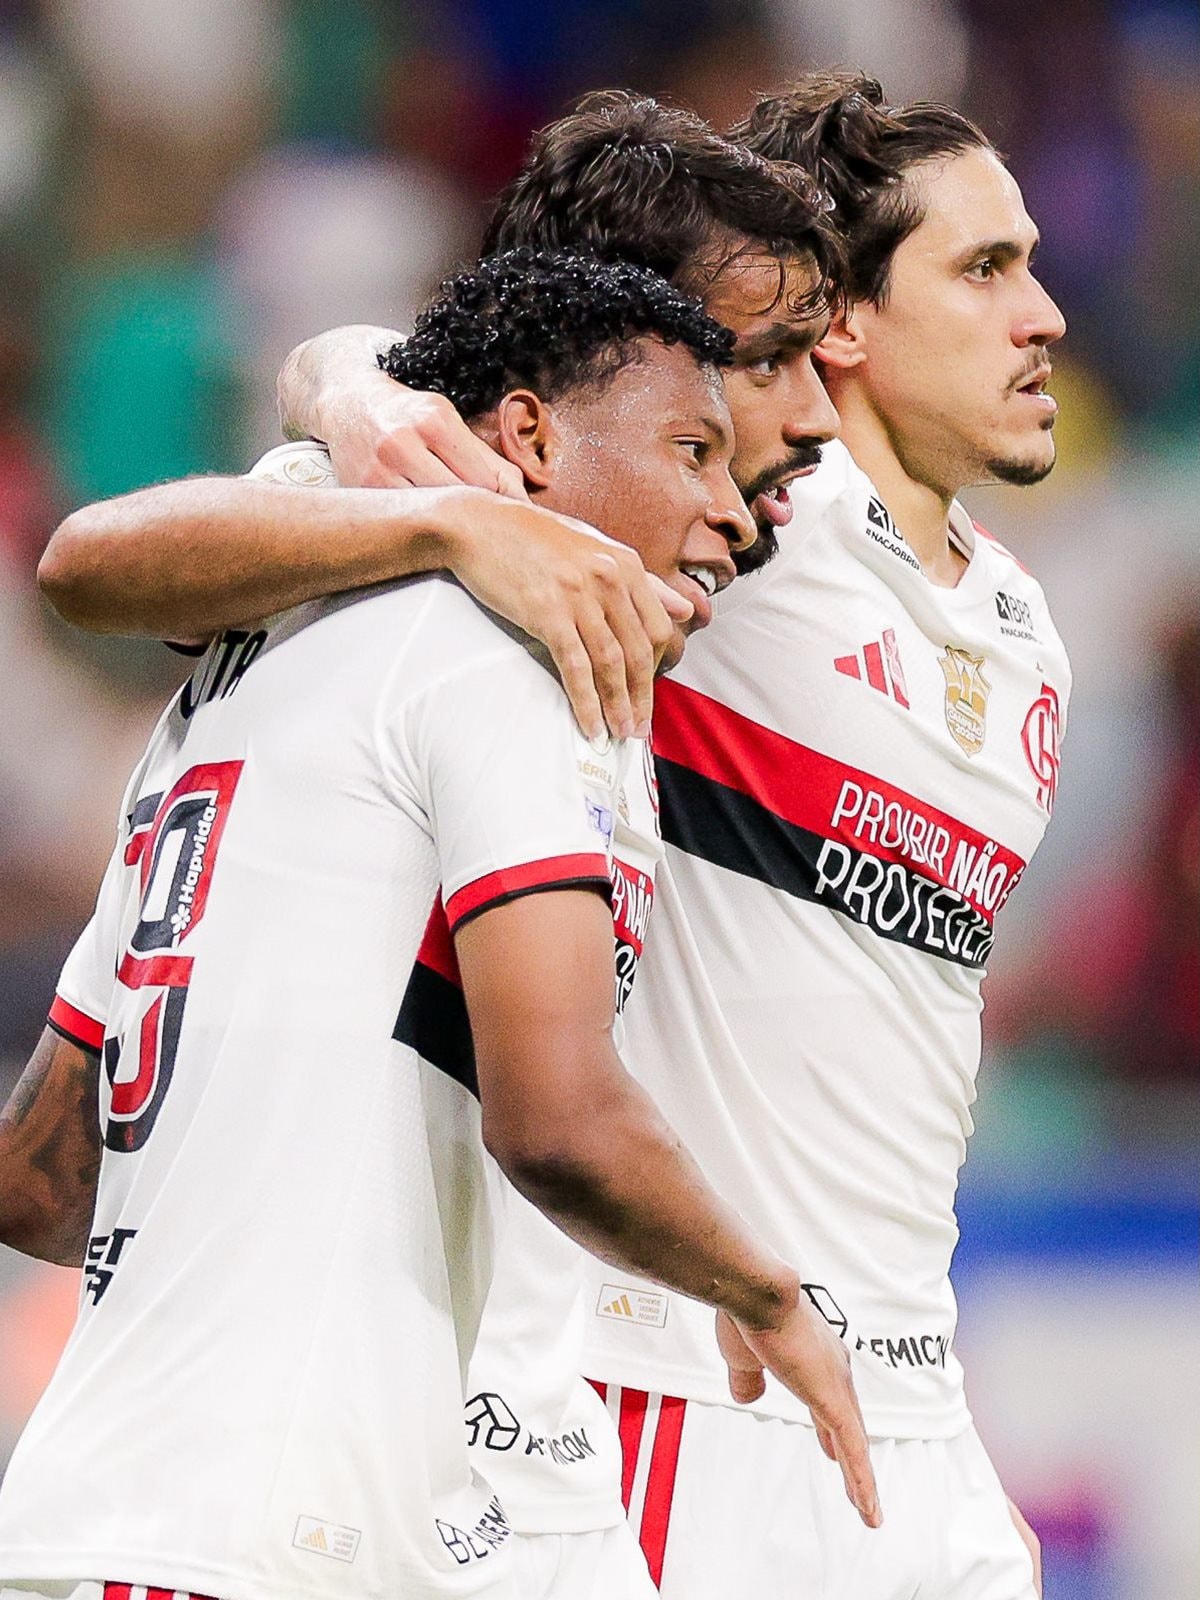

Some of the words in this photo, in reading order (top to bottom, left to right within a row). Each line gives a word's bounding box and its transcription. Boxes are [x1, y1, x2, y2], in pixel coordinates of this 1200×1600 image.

[178, 806, 218, 904] Hapvida
[831, 779, 951, 877] PROIBIR
[948, 840, 1008, 912] NÃO
